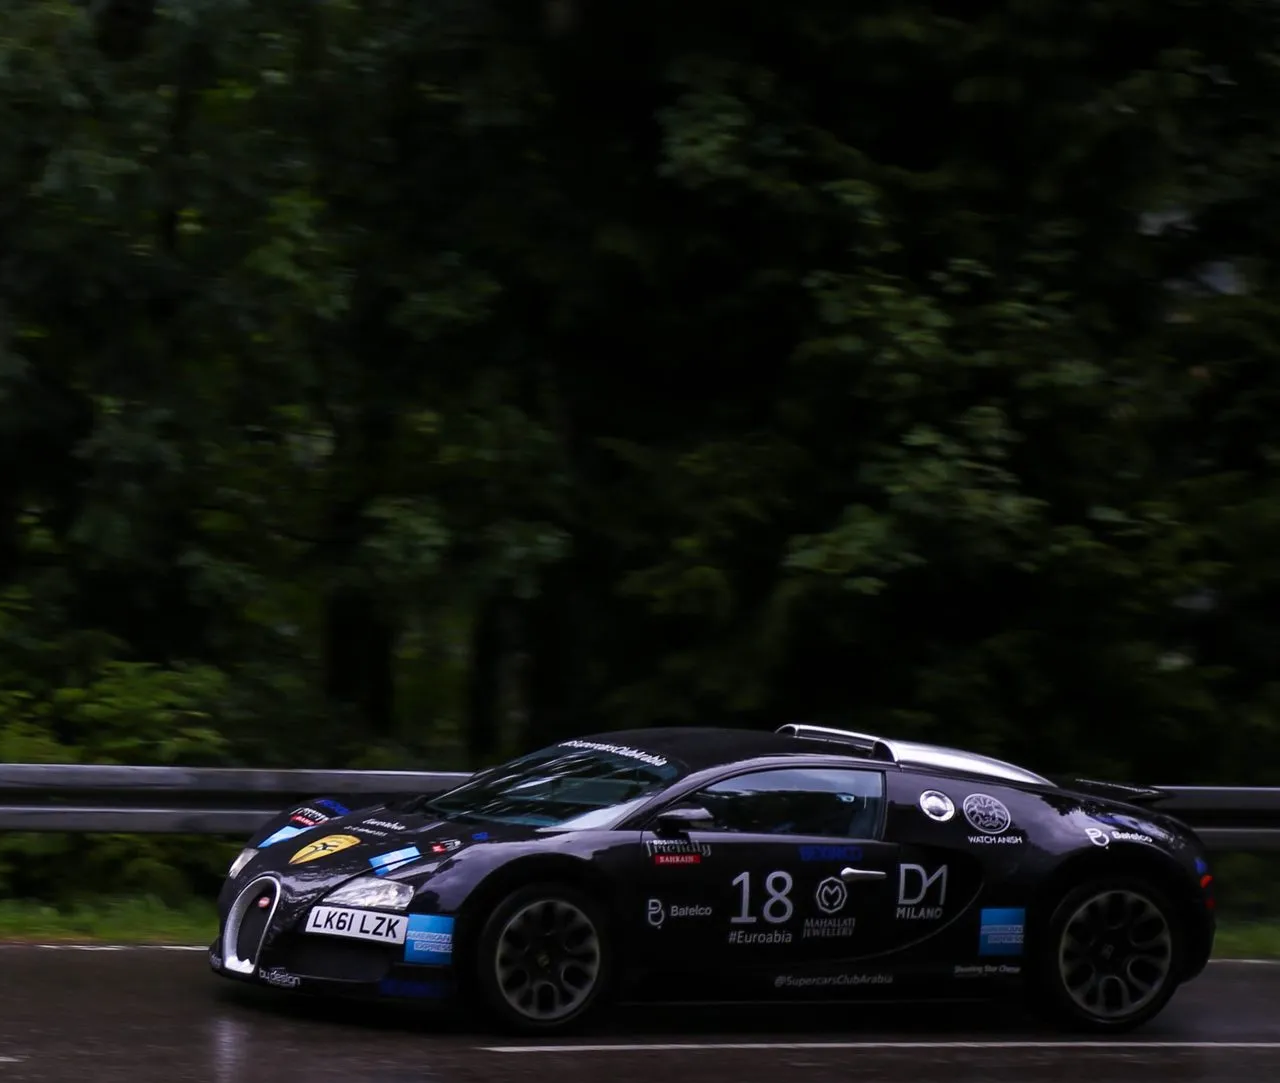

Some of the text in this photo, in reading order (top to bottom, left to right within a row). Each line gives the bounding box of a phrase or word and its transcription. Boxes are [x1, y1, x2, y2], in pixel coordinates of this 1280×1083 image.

[967, 836, 1023, 844] WATCH ANISH
[730, 871, 794, 924] 18
[670, 904, 713, 917] Batelco
[895, 907, 943, 920] MILANO
[359, 916, 400, 938] LZK
[729, 930, 793, 944] #Euroabia
